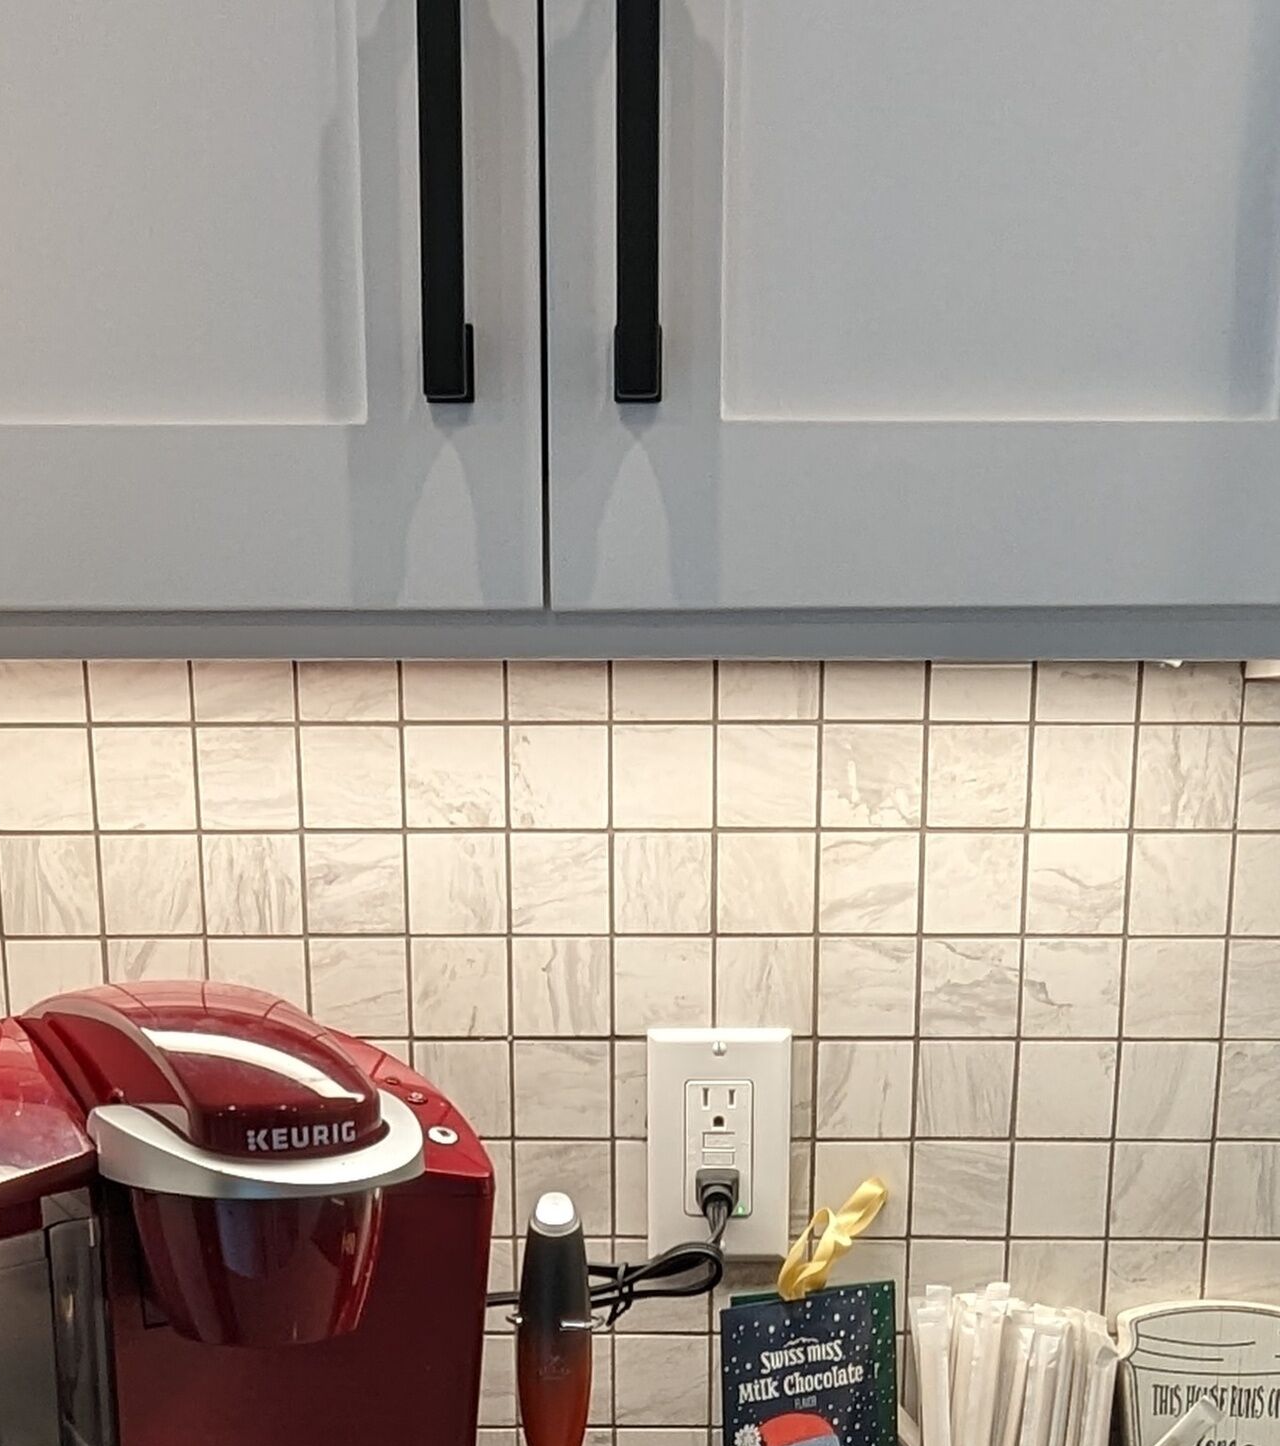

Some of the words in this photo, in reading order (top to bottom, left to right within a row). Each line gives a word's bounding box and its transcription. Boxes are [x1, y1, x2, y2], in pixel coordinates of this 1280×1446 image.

[246, 1120, 357, 1151] KEURIG
[738, 1376, 780, 1405] Milk
[783, 1361, 865, 1397] Chocolate
[1152, 1384, 1182, 1418] THIS
[1229, 1384, 1265, 1420] RUNS
